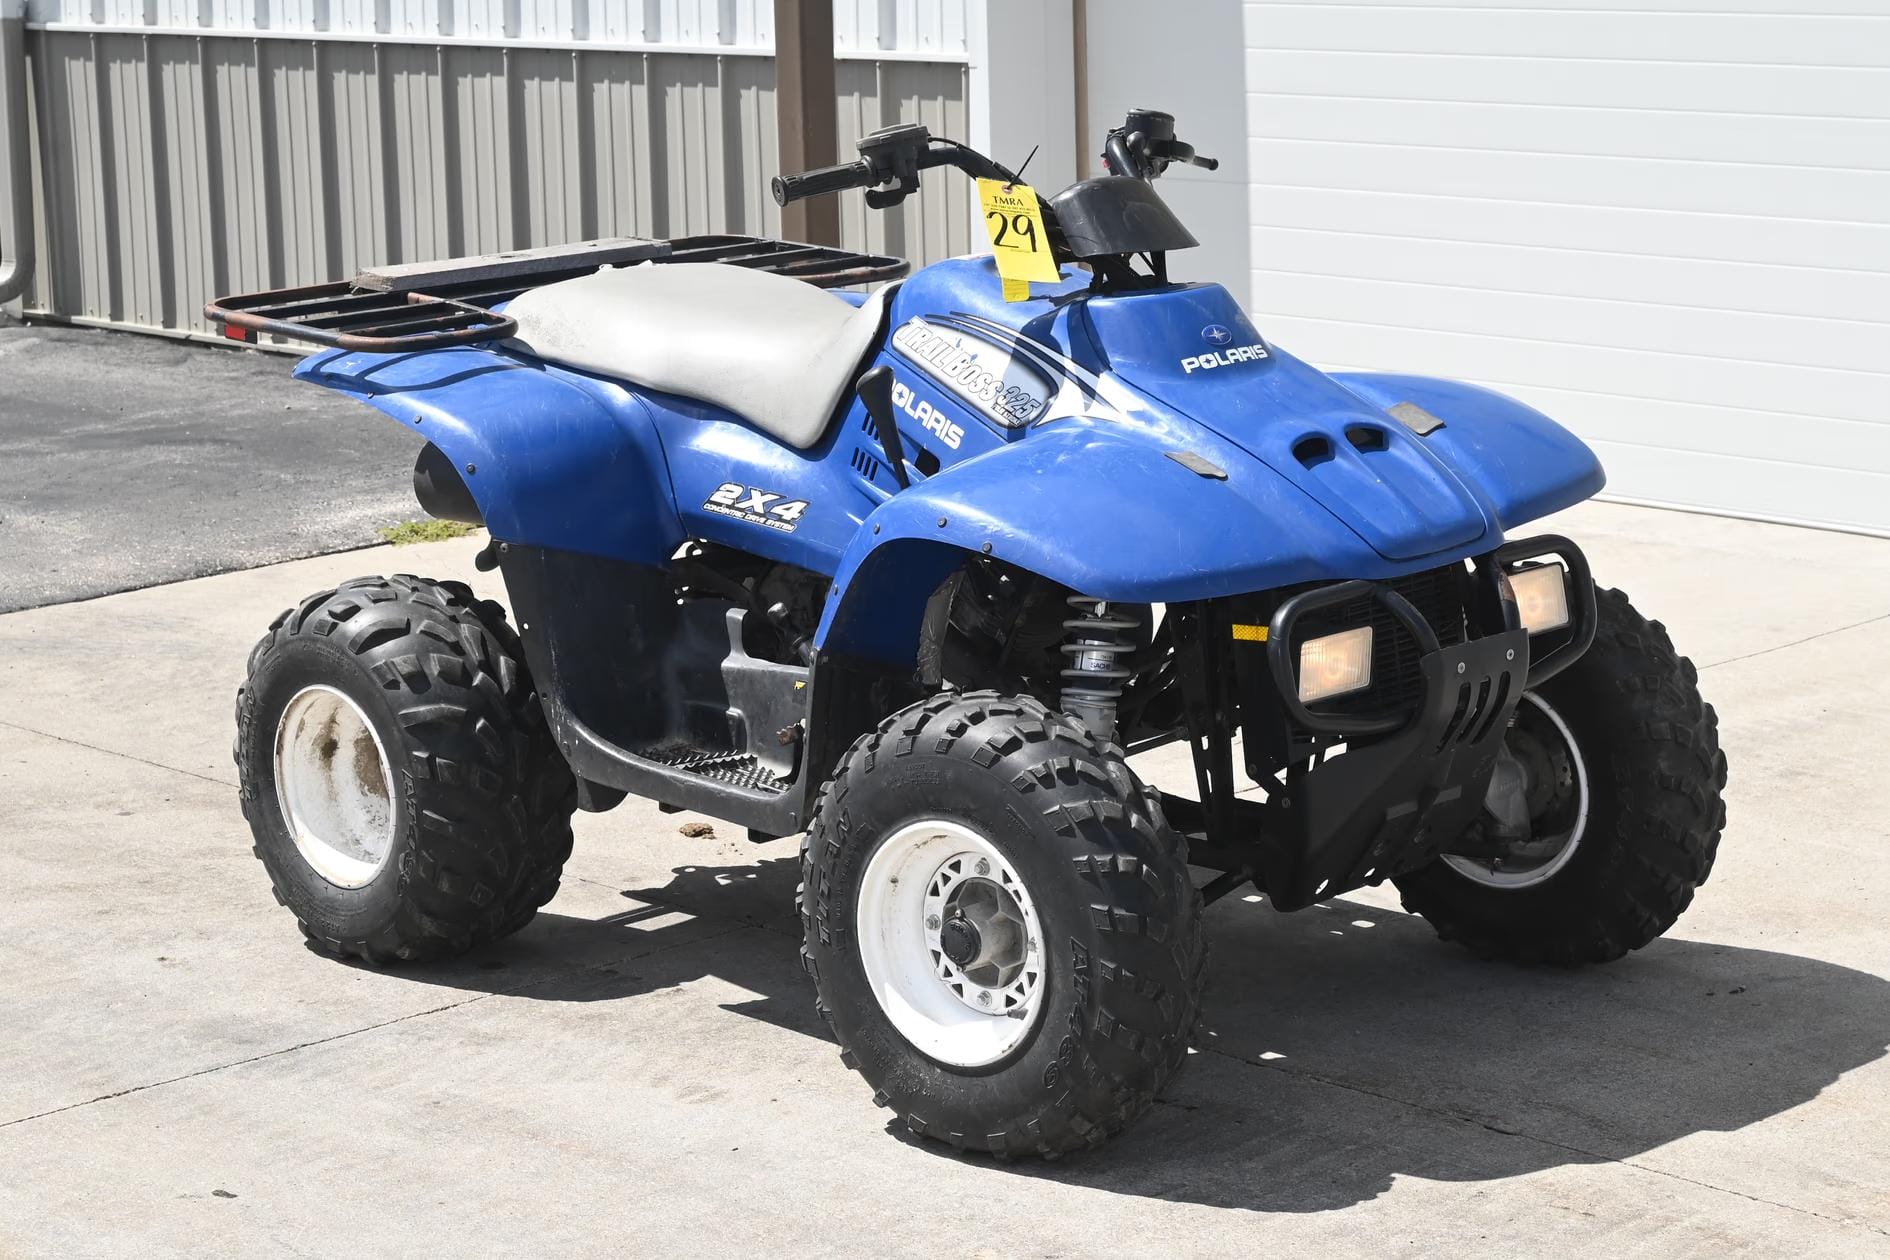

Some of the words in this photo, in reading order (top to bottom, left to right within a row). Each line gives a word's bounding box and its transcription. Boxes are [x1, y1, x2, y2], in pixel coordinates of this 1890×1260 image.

[992, 195, 1024, 206] TMRA
[986, 211, 1037, 252] 29
[897, 315, 955, 368] TRAIL
[941, 352, 1005, 401] BOSS
[996, 386, 1041, 419] 325
[1181, 344, 1268, 374] POLARIS
[892, 378, 965, 450] OLARIS
[703, 503, 746, 519] CONCENTRIC
[744, 513, 767, 525] DRIVE
[765, 519, 796, 531] SYSTEM
[708, 482, 811, 521] 2X4
[816, 808, 851, 944] TITAN
